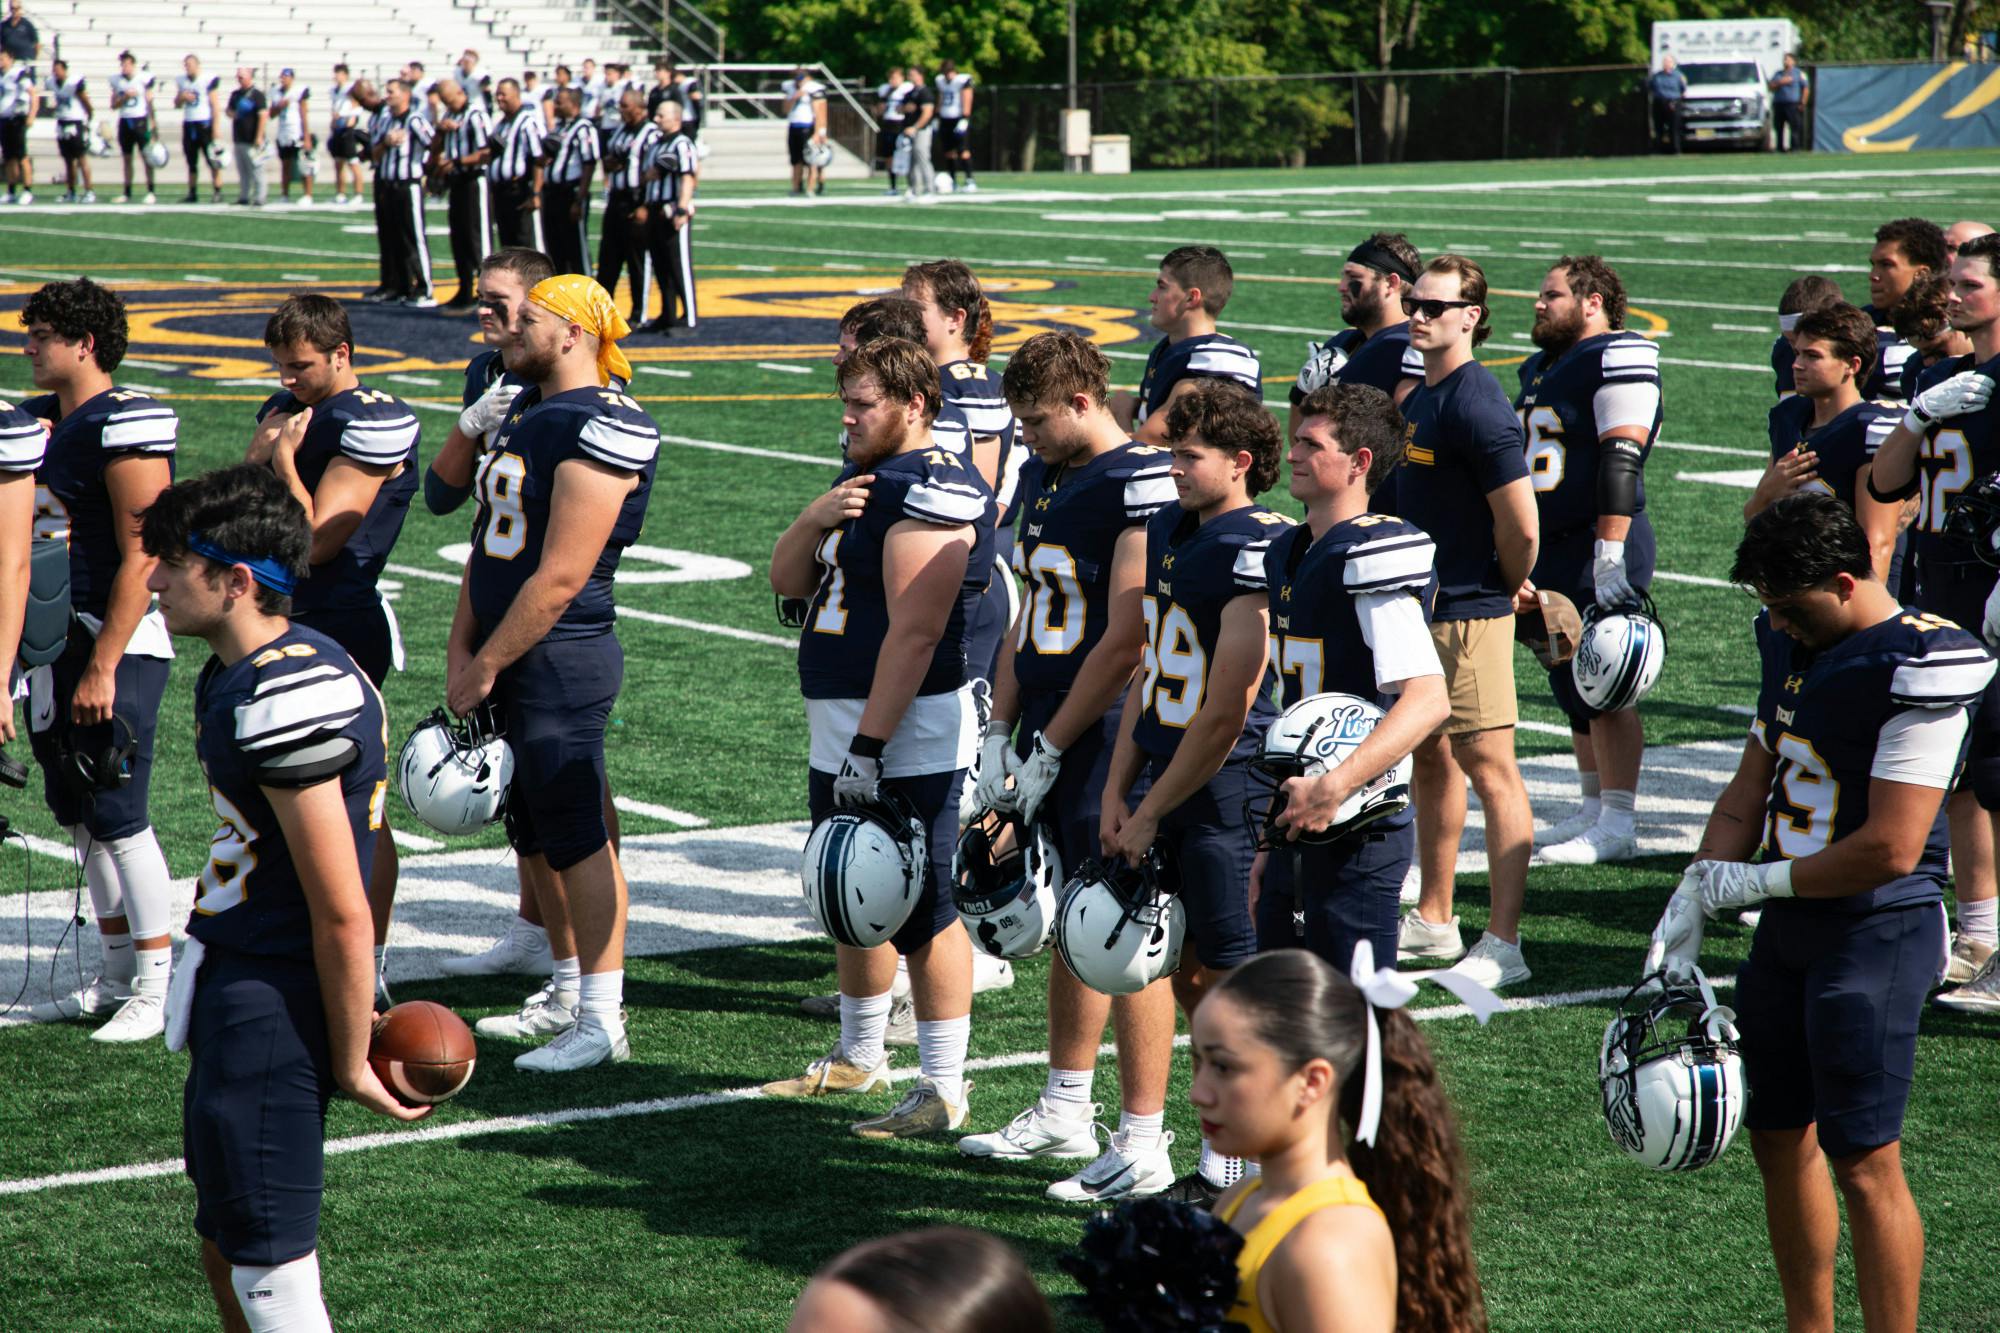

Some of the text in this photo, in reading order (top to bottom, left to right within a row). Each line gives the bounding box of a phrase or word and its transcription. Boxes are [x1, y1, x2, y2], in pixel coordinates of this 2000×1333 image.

[948, 363, 988, 380] 67
[921, 450, 964, 471] 71
[1517, 406, 1566, 491] 6
[1917, 429, 1974, 533] 2
[1269, 633, 1325, 702] 7
[1316, 705, 1382, 757] Lion
[1386, 770, 1397, 784] 97
[1757, 718, 1840, 860] 9
[832, 814, 861, 823] Riddell
[963, 900, 994, 914] TCNJ
